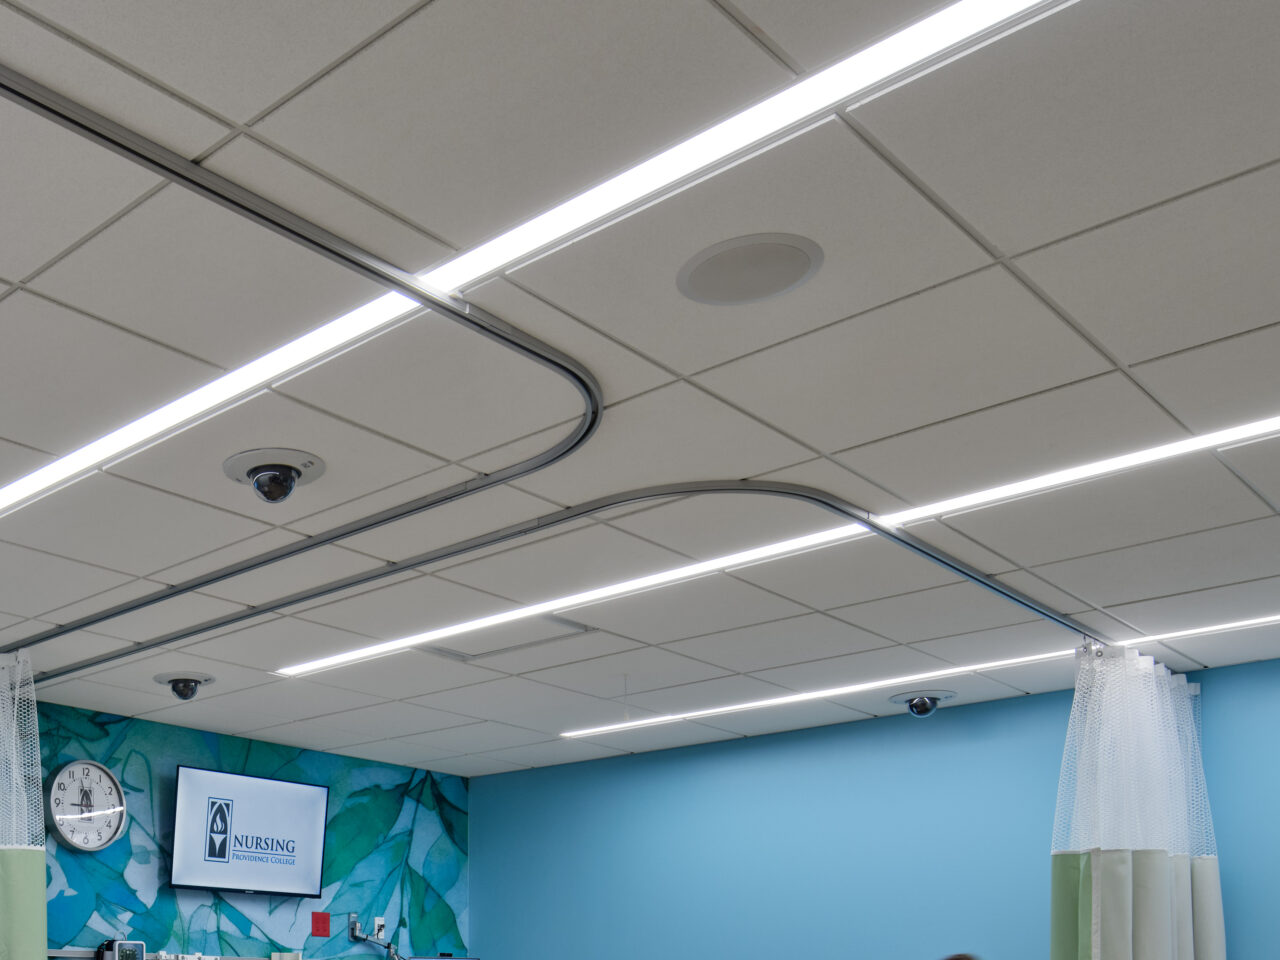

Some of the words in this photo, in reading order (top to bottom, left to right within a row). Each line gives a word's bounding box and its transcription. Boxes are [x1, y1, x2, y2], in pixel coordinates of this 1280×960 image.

[69, 770, 75, 779] 11
[82, 767, 90, 777] 12
[99, 774, 102, 784] 1
[57, 782, 66, 791] 10
[107, 786, 113, 796] 2
[54, 798, 61, 808] 9
[105, 820, 112, 829] 4
[69, 829, 75, 840] 7
[97, 831, 102, 841] 5
[82, 835, 89, 845] 6
[233, 834, 296, 853] NURSING
